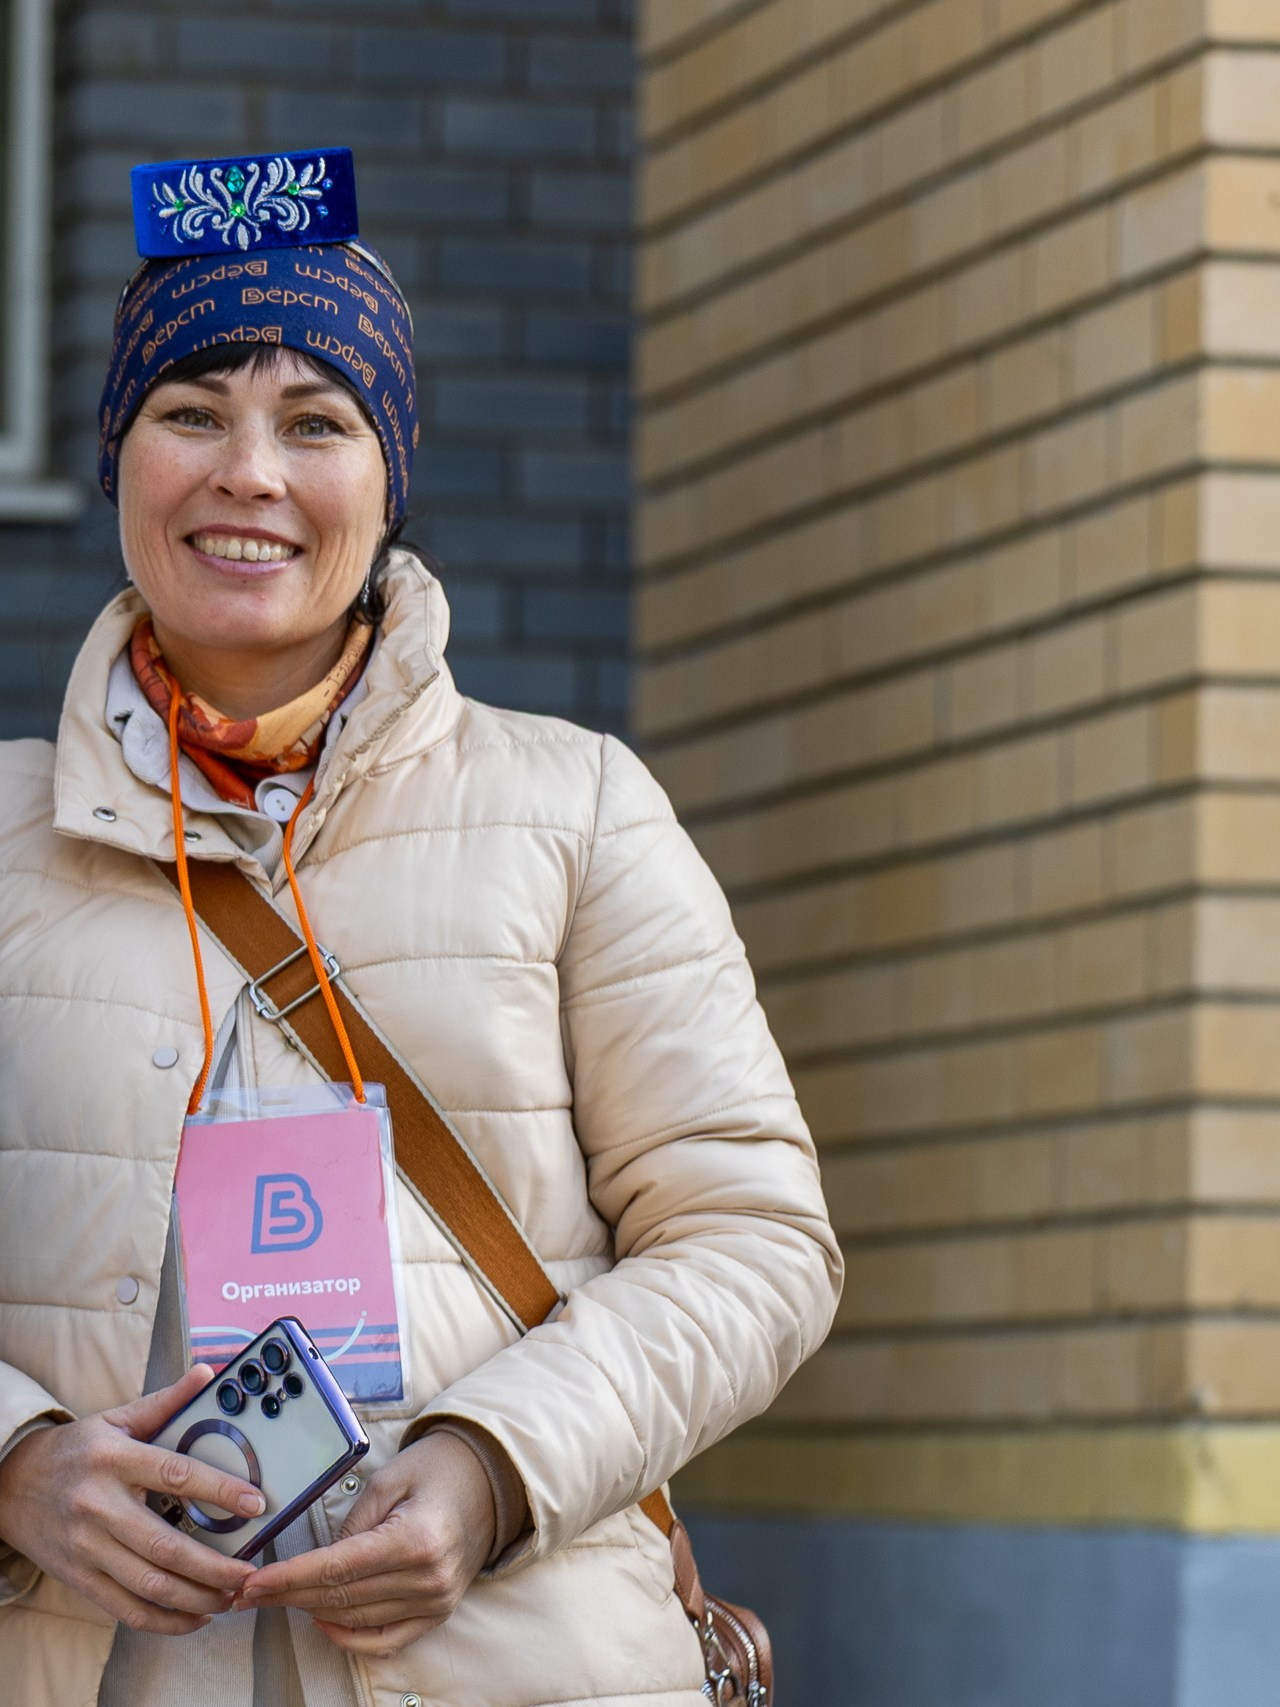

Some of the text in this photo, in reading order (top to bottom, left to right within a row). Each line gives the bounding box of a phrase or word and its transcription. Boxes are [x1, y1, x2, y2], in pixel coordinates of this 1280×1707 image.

[241, 285, 339, 316] Вёрст
[141, 297, 216, 366] Вёрст
[305, 329, 377, 389] Вёрст
[221, 1277, 362, 1303] Организатор
